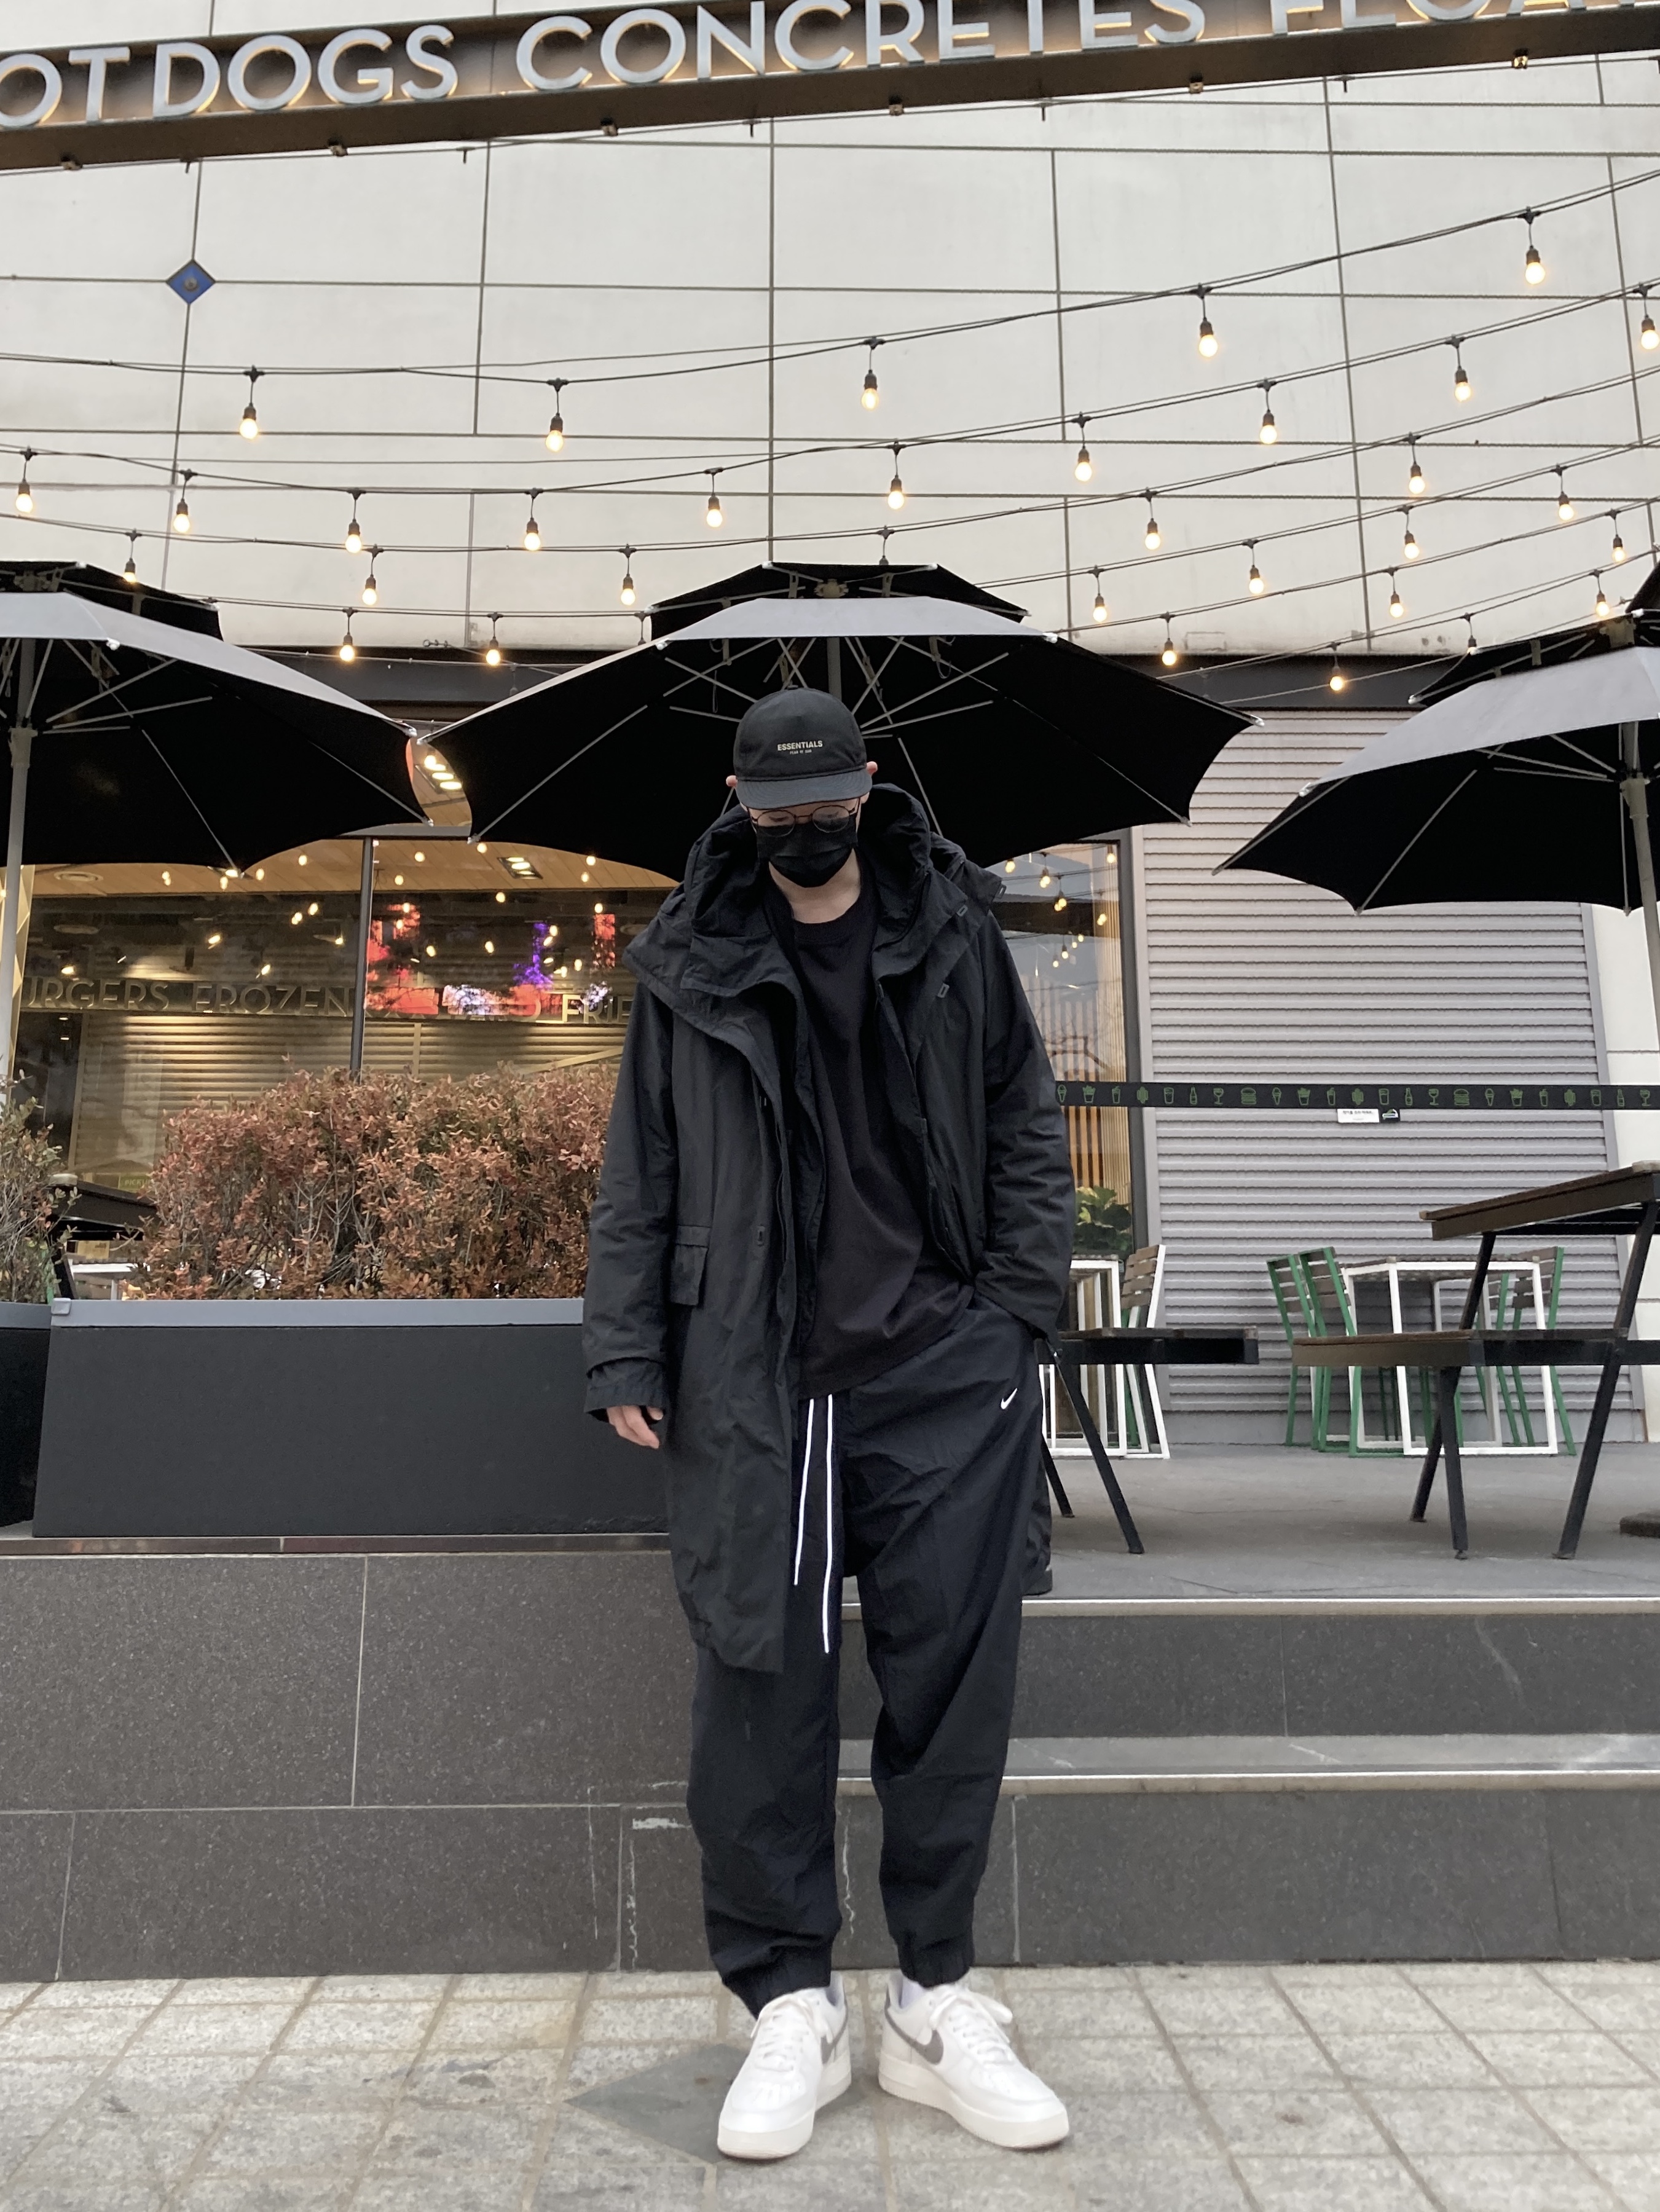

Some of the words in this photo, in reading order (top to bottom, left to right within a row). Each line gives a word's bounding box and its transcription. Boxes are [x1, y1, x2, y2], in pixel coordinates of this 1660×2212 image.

[0, 47, 131, 128] OT
[153, 25, 458, 117] DOGS
[516, 0, 1206, 91] CONCRETES
[777, 740, 823, 750] ESSENTIALS
[191, 983, 350, 1016] FROZEN
